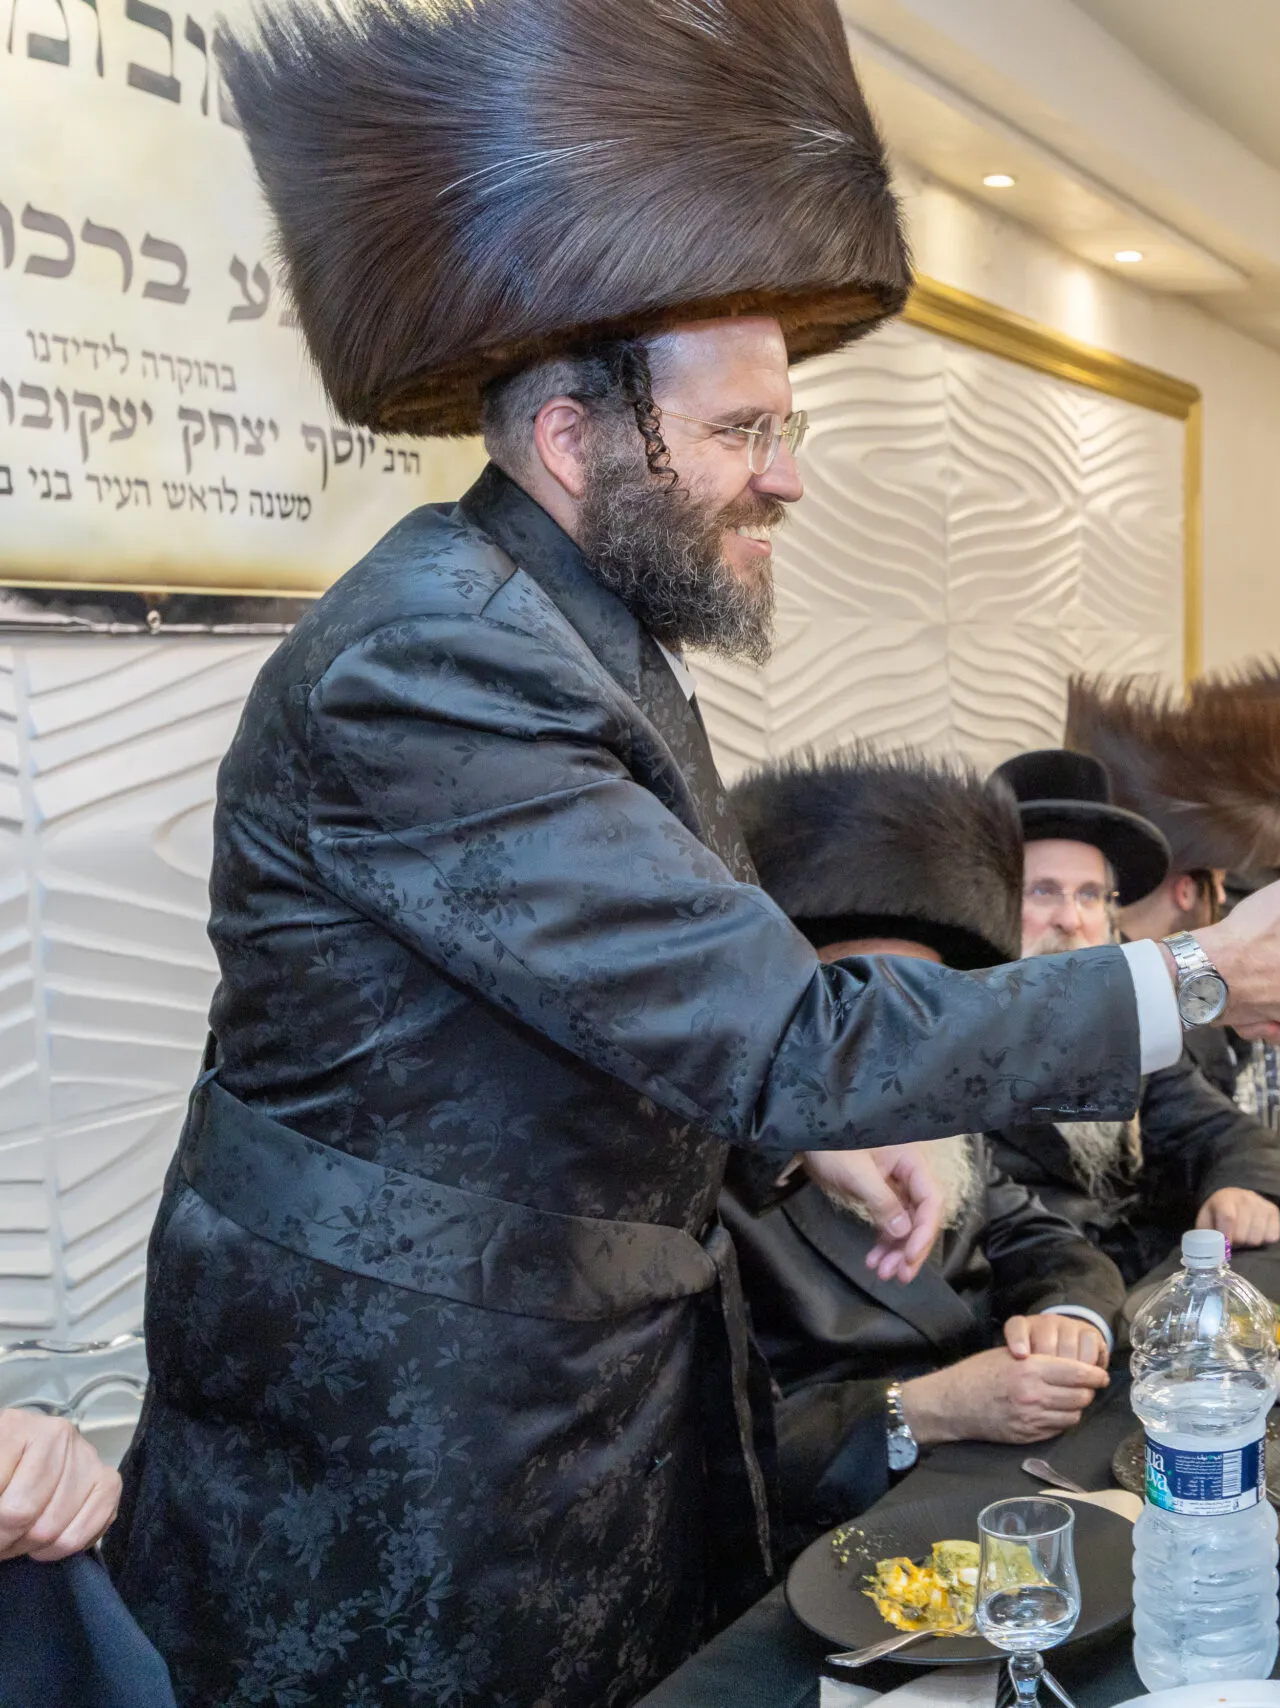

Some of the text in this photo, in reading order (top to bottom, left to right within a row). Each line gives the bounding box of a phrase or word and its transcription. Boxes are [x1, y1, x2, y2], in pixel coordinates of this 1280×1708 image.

[125, 0, 246, 131] וב
[26, 331, 236, 394] בהוקרה לידידנו
[0, 377, 421, 491] הרב יוסף יצחק יעקובו
[28, 466, 72, 501] בני
[86, 473, 151, 511] העיר
[162, 475, 238, 514] לראש
[249, 490, 312, 521] משנה
